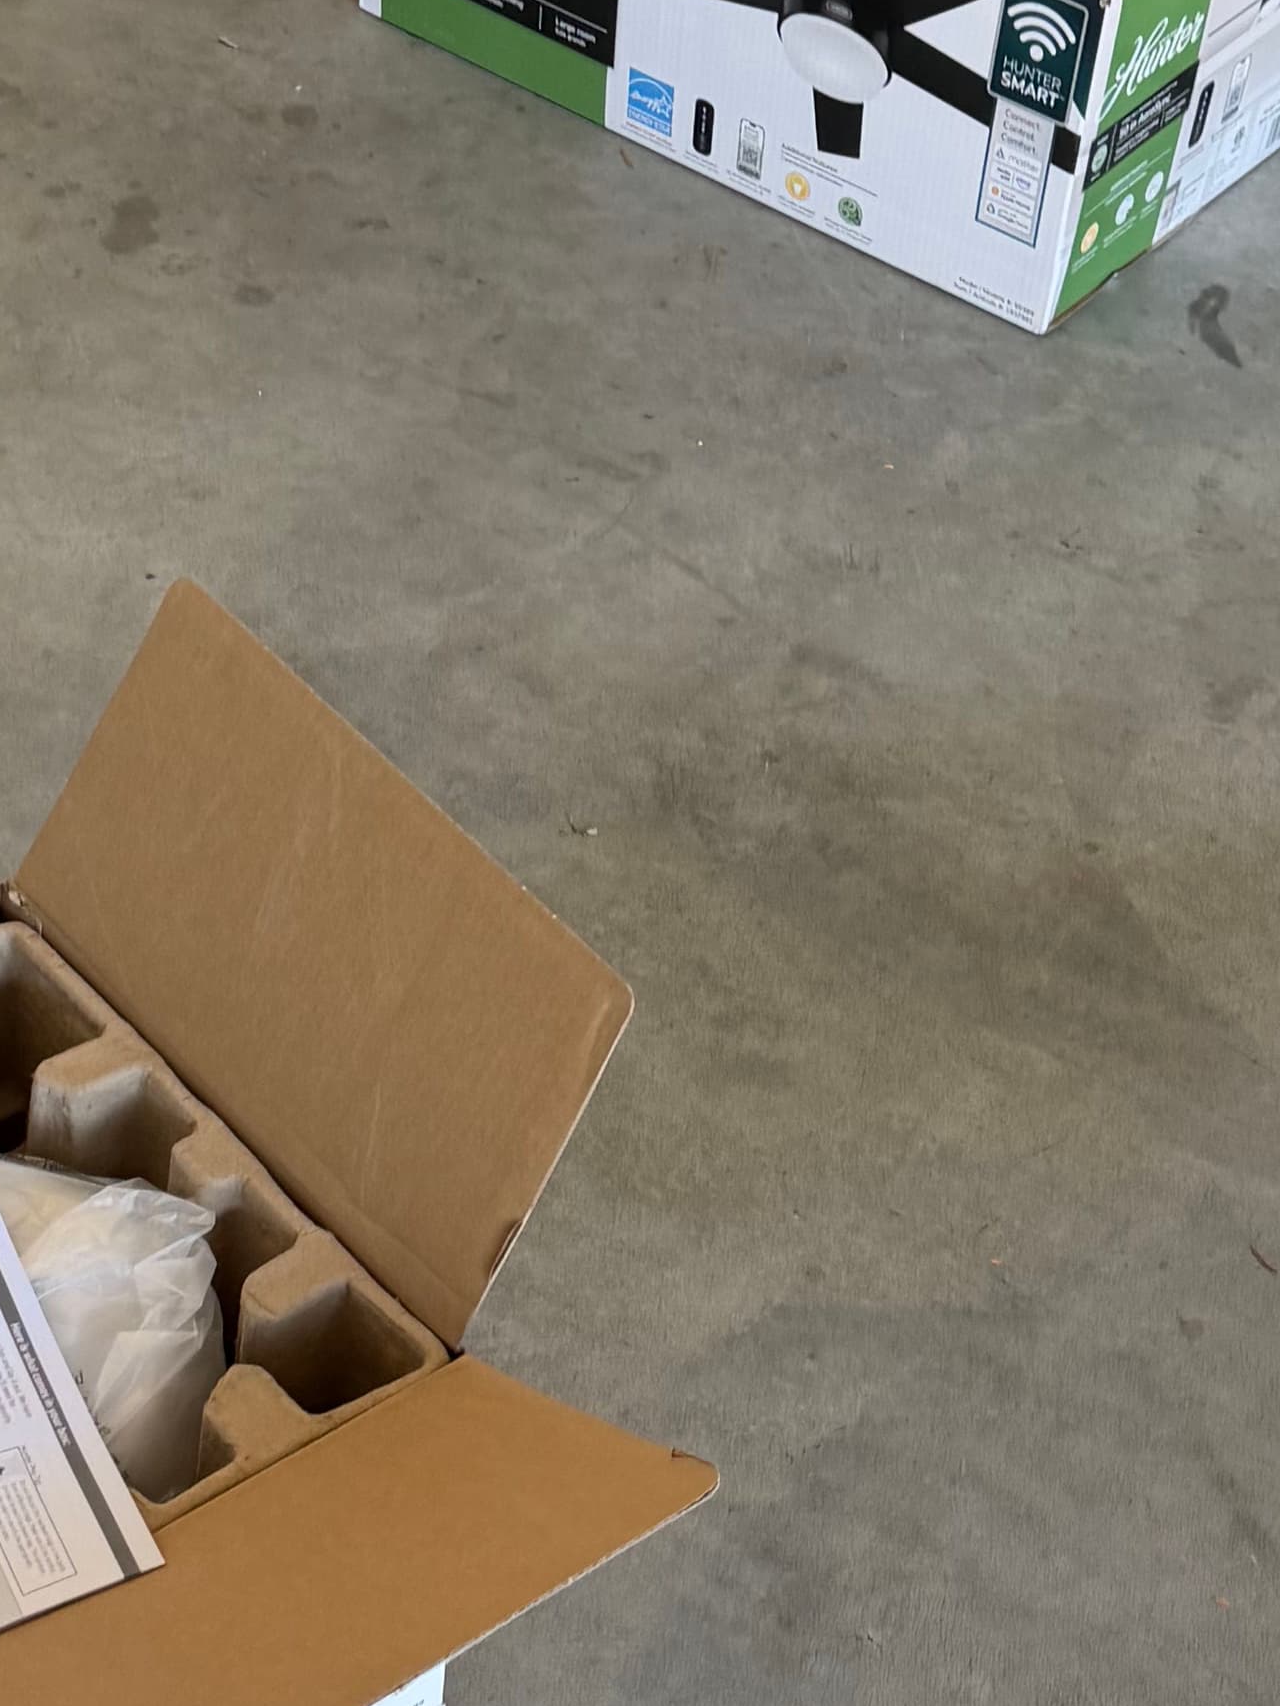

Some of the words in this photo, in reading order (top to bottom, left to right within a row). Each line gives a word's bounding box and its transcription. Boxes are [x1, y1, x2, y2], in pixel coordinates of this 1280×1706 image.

[1002, 54, 1061, 93] HUNTER
[1099, 13, 1205, 118] Hunter
[628, 107, 653, 127] ENERGY
[654, 119, 670, 135] STAR
[8, 1320, 27, 1344] Here
[18, 1341, 30, 1351] is
[22, 1350, 40, 1373] what
[31, 1371, 50, 1399] comes
[43, 1397, 56, 1408] in
[44, 1406, 63, 1429] your
